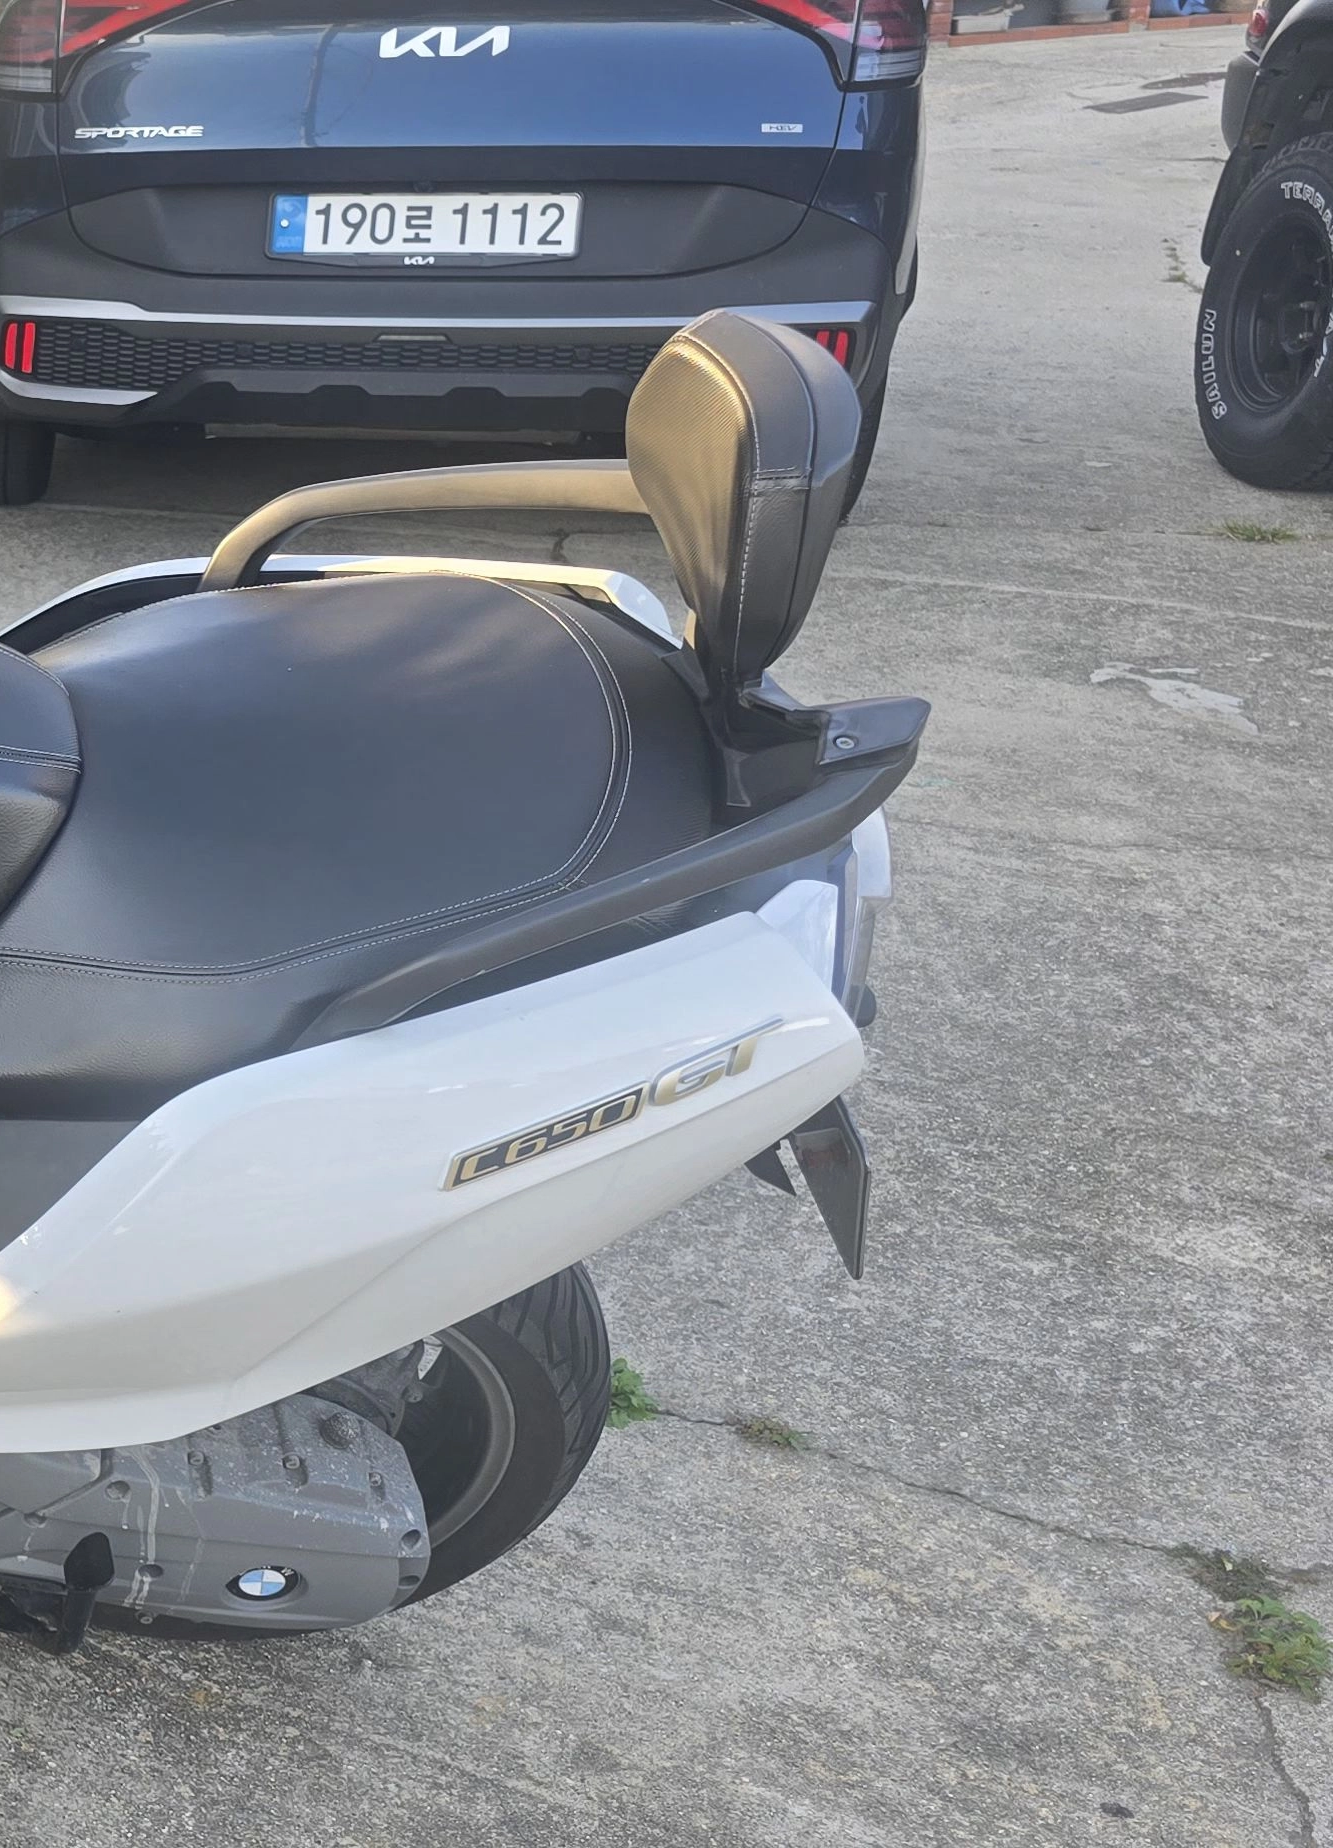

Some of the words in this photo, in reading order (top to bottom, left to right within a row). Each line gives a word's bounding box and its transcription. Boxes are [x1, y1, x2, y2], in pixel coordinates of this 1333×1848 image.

[379, 26, 510, 58] KIA
[75, 125, 204, 138] SPORTAGE
[315, 202, 433, 245] 190로
[452, 202, 565, 245] 1112
[1201, 308, 1227, 419] SAILUN
[460, 1094, 637, 1181] C650
[649, 1015, 783, 1106] GT
